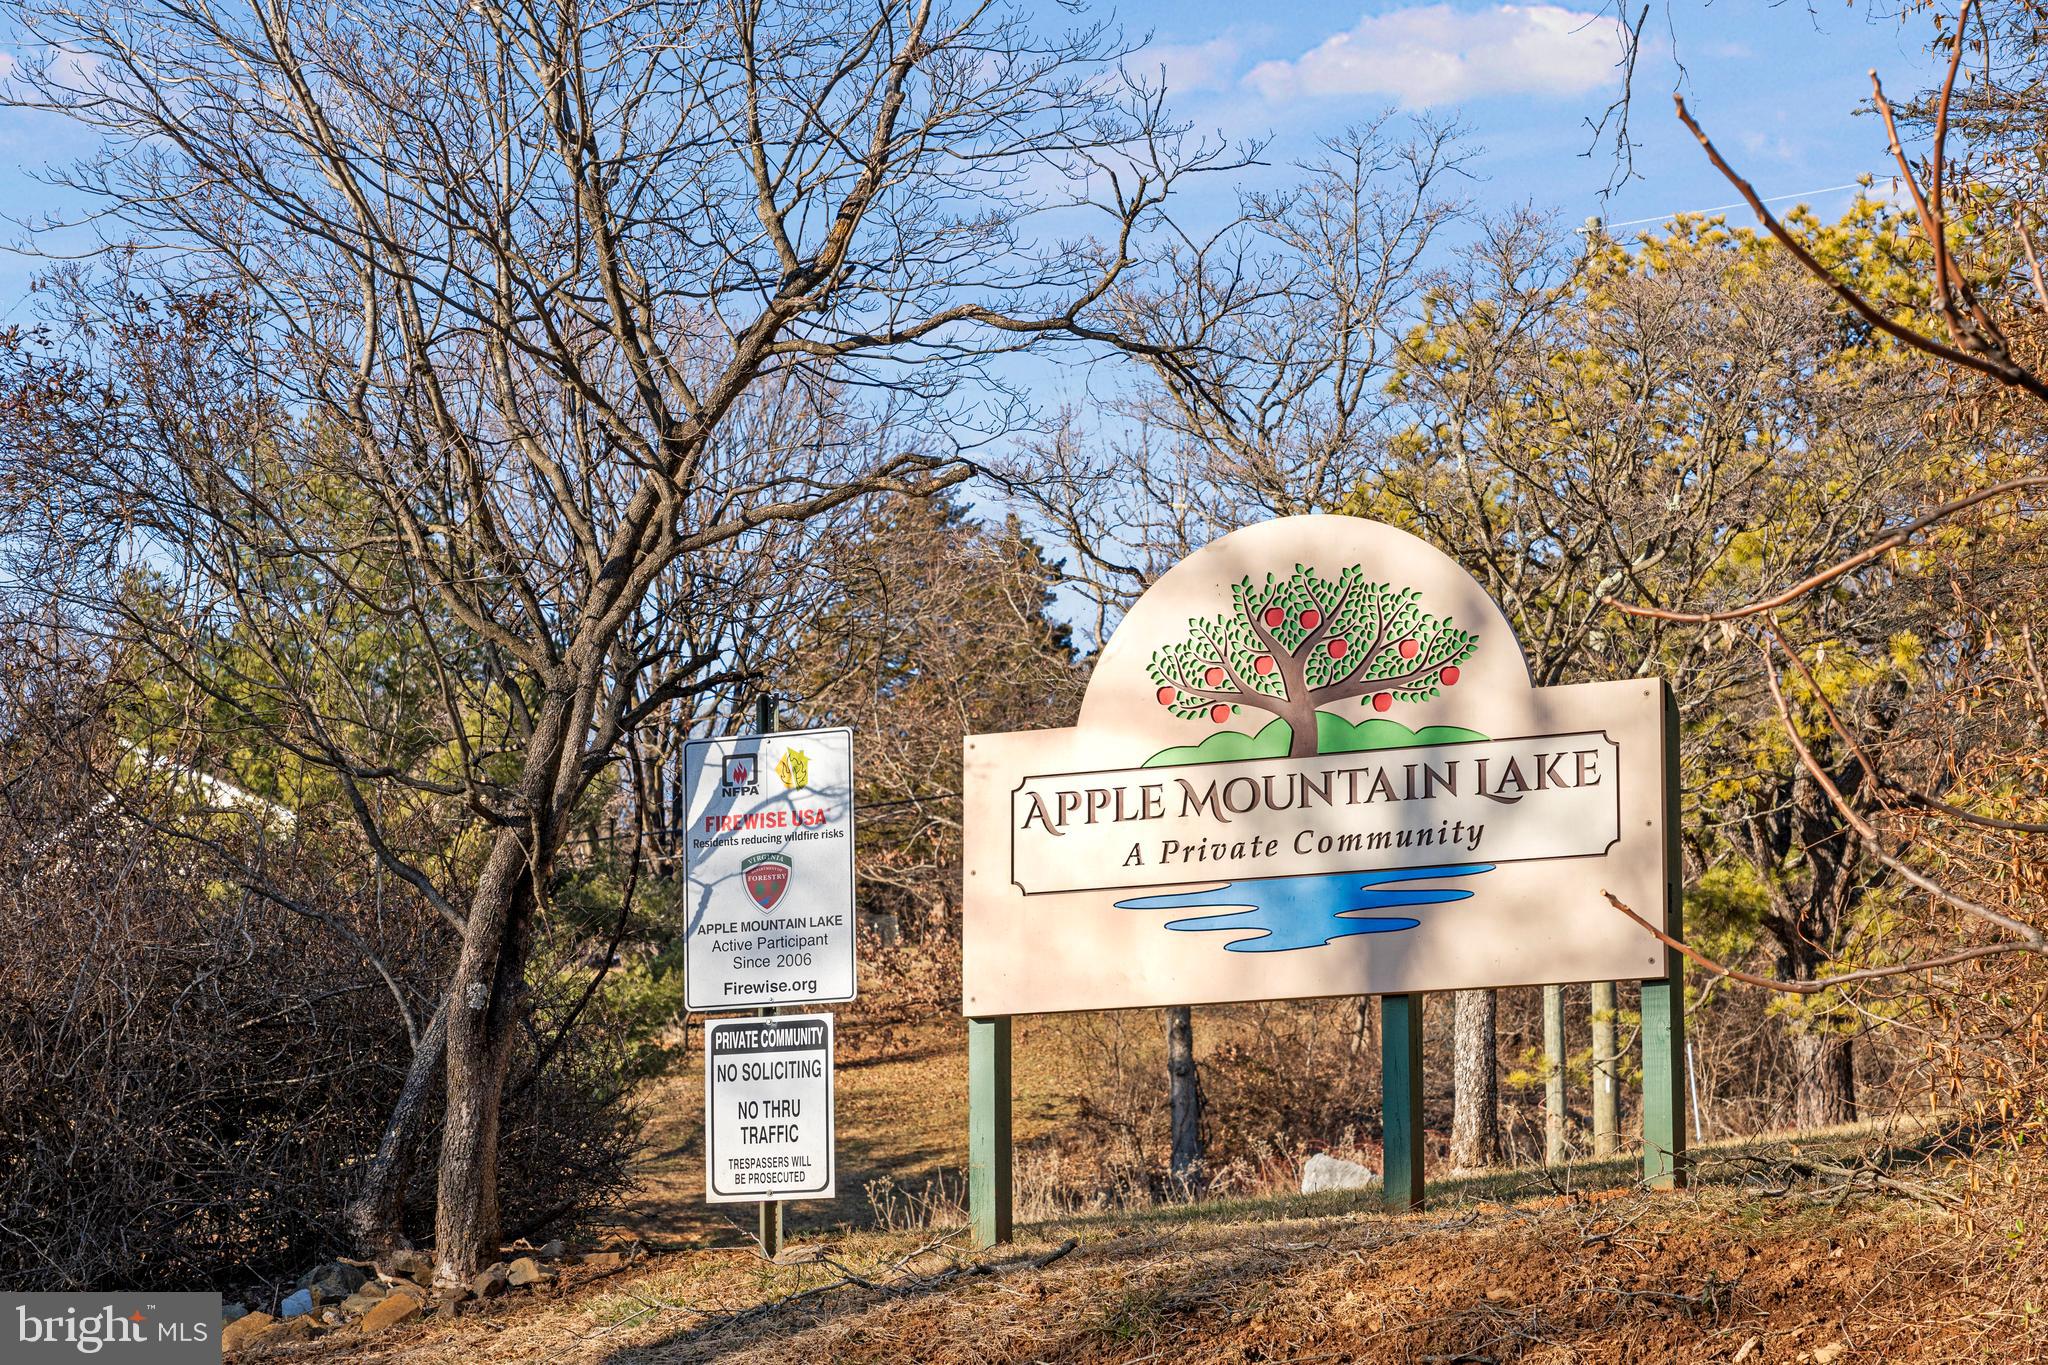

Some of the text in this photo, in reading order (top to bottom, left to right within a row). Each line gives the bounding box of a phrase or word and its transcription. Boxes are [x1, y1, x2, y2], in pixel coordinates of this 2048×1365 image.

[722, 786, 758, 797] NFPA
[1021, 749, 1602, 836] APPLE MOUNTAIN LAKE
[705, 808, 826, 832] FIREWISE USA
[693, 829, 844, 849] Residents reducing wildfire risks
[1122, 819, 1486, 867] A Private Community
[747, 873, 787, 882] FORESTRY
[697, 915, 843, 935] APPLE MOUNTAIN LAKE
[712, 933, 828, 952] Active Participant
[733, 953, 812, 970] Since 2006
[724, 979, 817, 996] Firewise.org
[715, 1026, 824, 1050] PRIVATE COMMUNITY
[717, 1059, 822, 1082] NO SOLICITING
[738, 1099, 801, 1120] NO THRU
[740, 1124, 799, 1145] TRAFFIC
[728, 1155, 812, 1170] TRESPASSERS WILL
[734, 1171, 806, 1185] BE PROSECUTED
